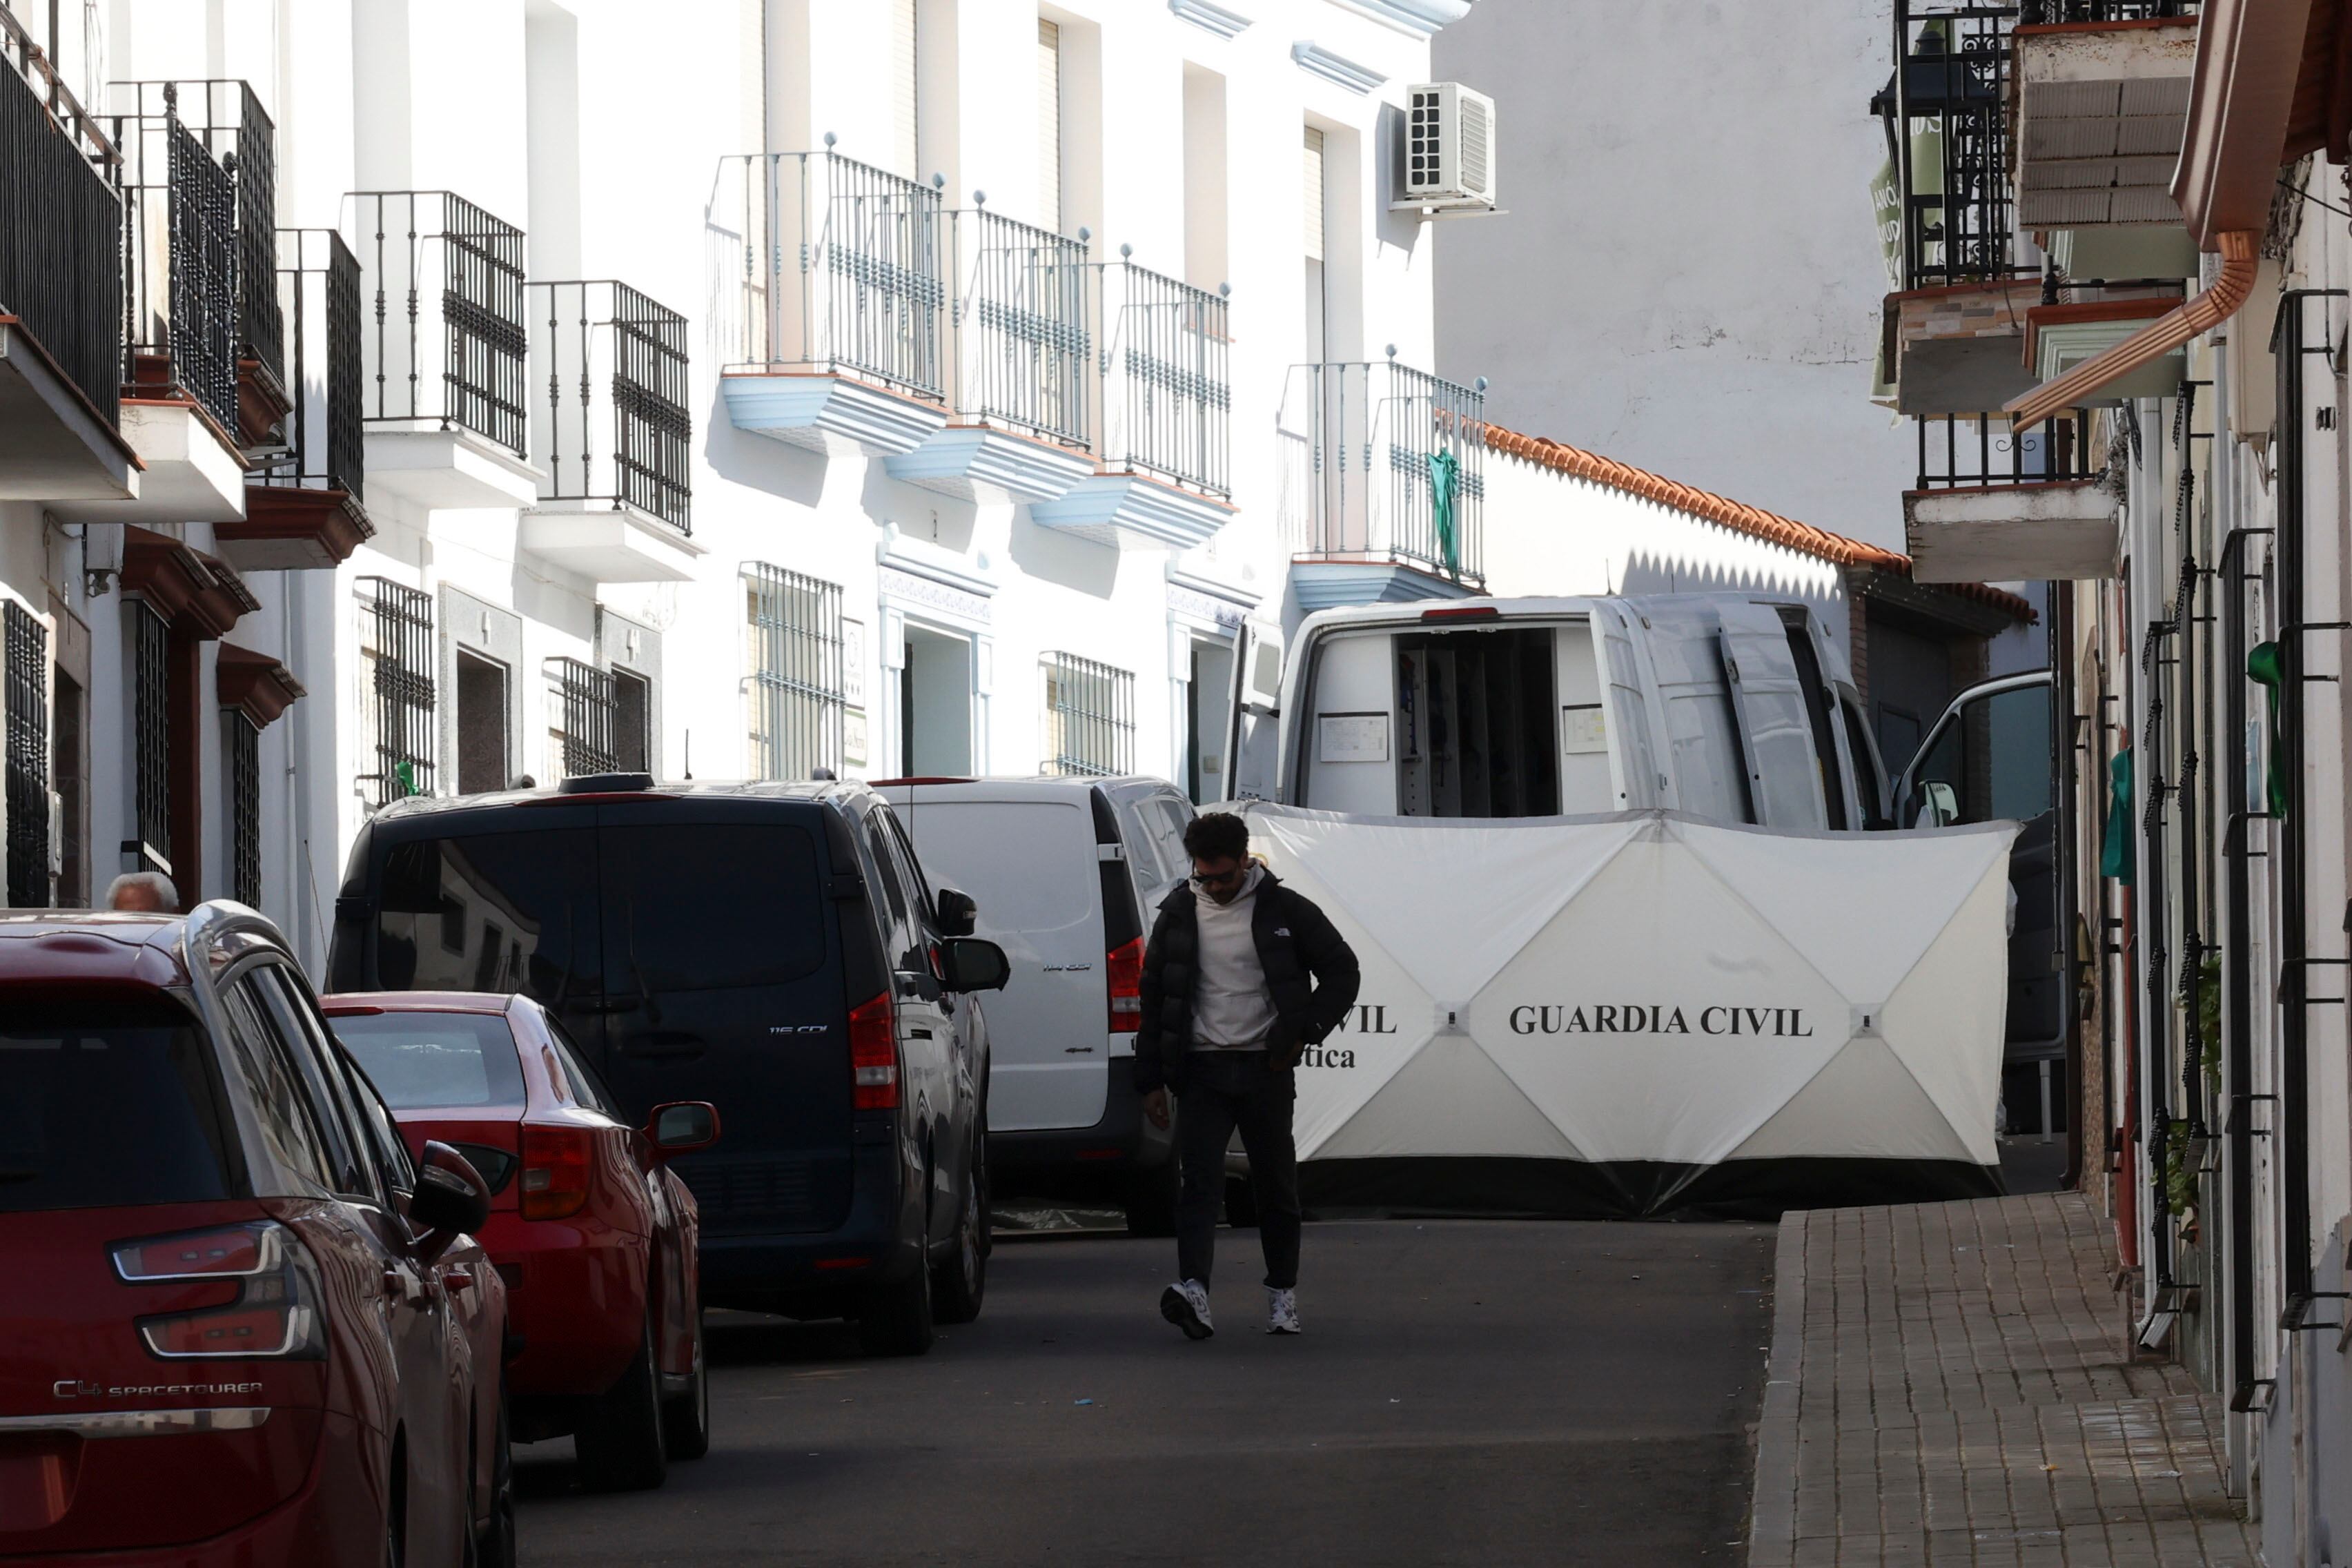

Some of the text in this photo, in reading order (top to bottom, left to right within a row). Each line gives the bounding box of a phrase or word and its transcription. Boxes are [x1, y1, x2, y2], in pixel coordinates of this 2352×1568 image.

[796, 1025, 828, 1035] CDI
[1509, 1005, 1814, 1037] GUARDIA CIVIL
[53, 1380, 263, 1398] C4 SPACETOURER
